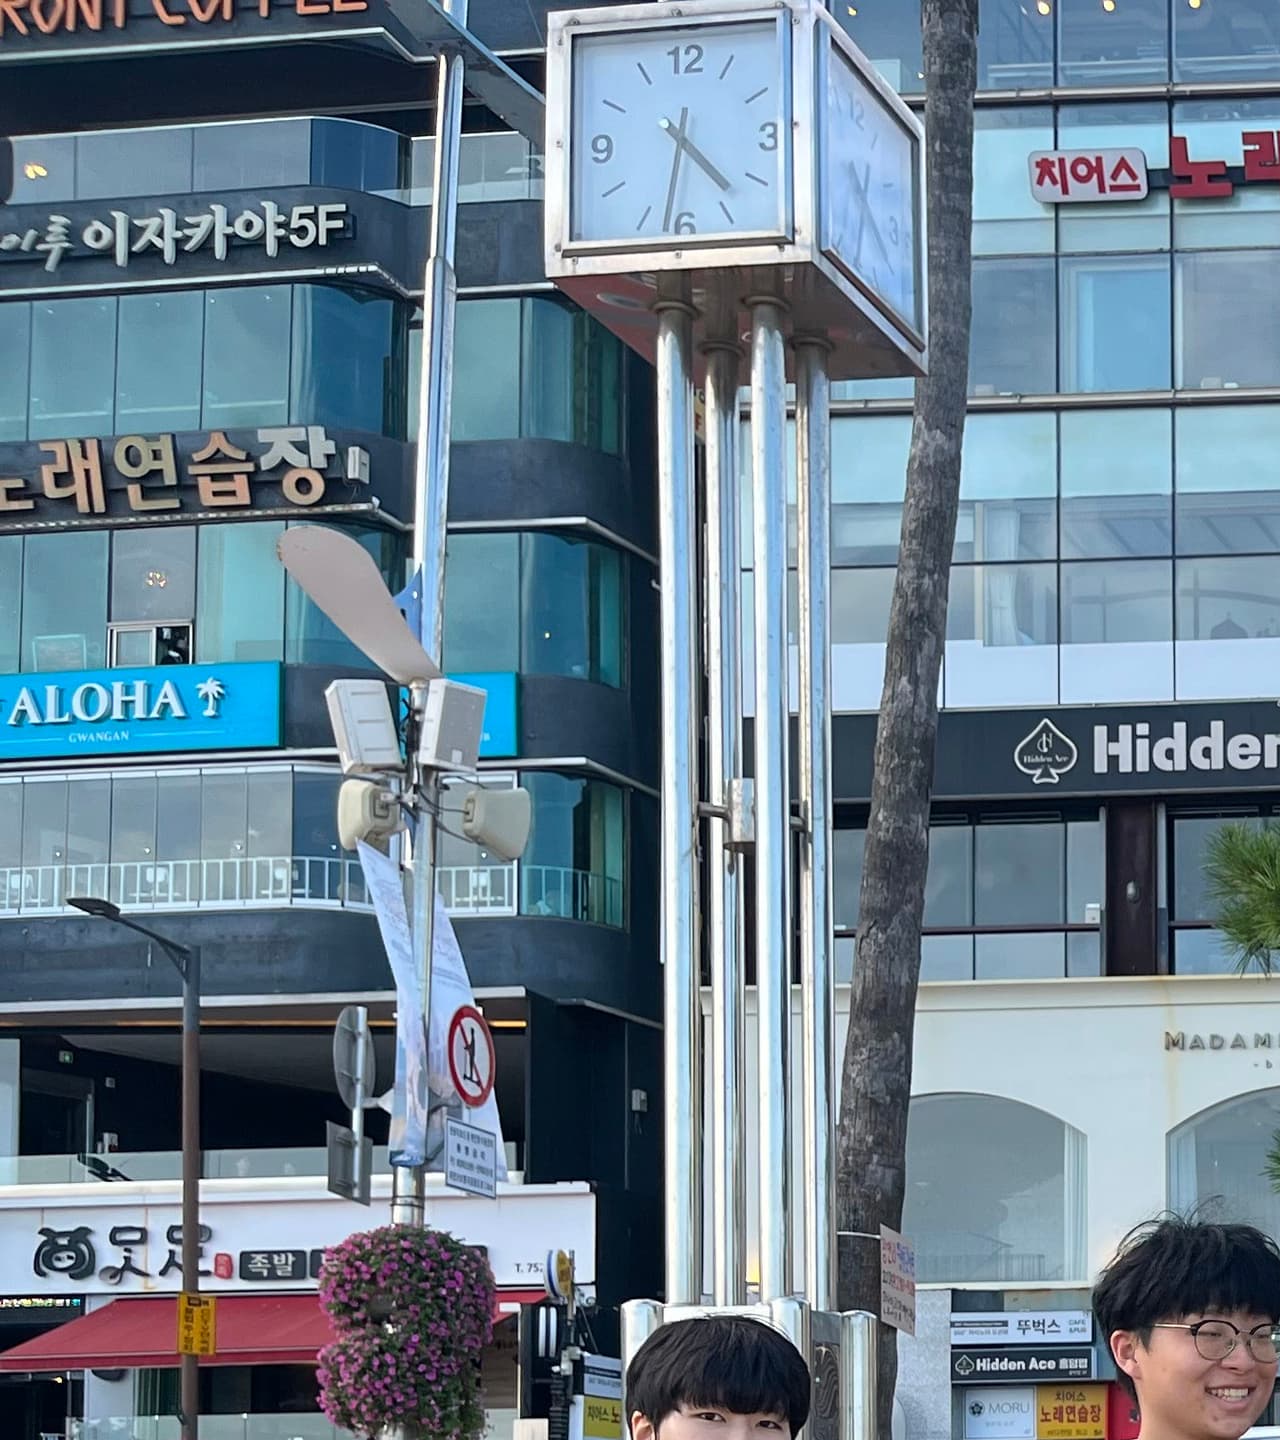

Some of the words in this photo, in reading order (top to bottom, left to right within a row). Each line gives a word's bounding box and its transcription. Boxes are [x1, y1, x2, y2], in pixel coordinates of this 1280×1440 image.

[667, 45, 704, 75] 12
[759, 121, 779, 152] 3
[591, 134, 614, 164] 9
[1035, 155, 1141, 196] 치어스
[674, 211, 697, 236] 6
[7, 679, 189, 726] ALOHA
[68, 731, 130, 744] GWANGAN
[247, 1253, 296, 1277] 족발
[1016, 1318, 1062, 1335] 뚜벅스
[976, 1358, 1026, 1372] Hidden
[1029, 1357, 1056, 1371] Ace
[988, 1402, 1030, 1415] MORU
[1055, 1391, 1087, 1402] 치어스
[1039, 1403, 1102, 1424] 노래연습장
